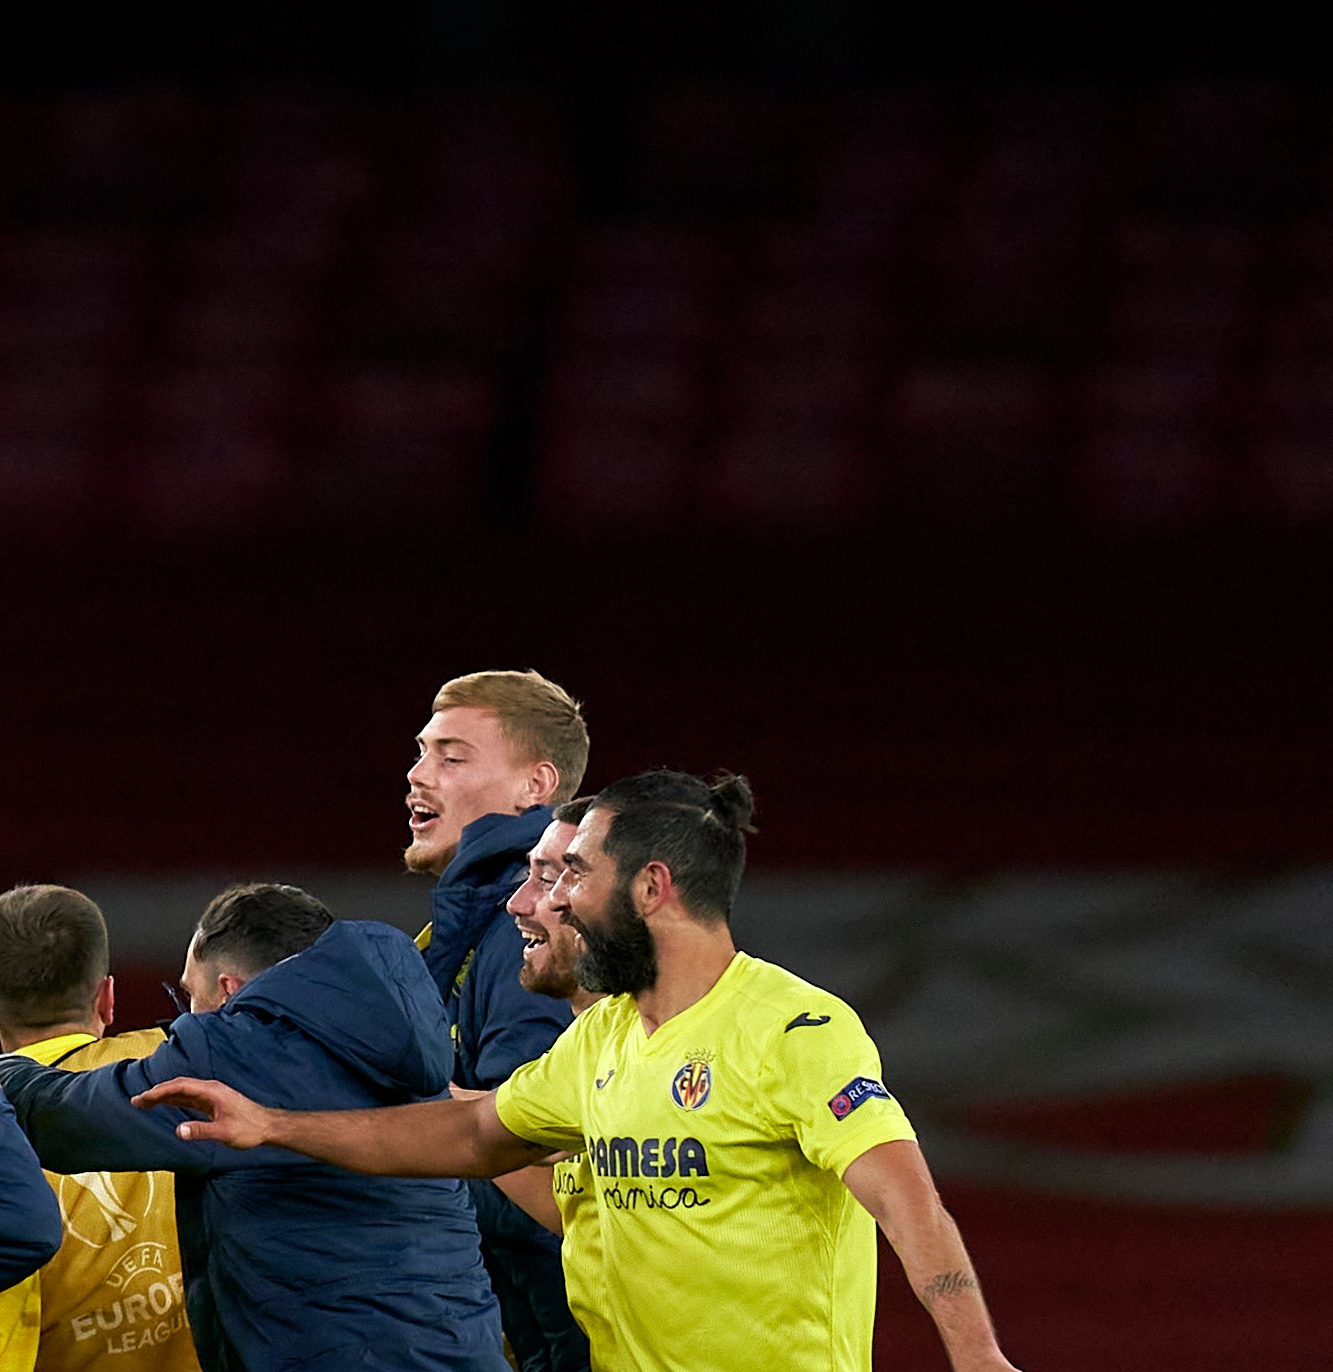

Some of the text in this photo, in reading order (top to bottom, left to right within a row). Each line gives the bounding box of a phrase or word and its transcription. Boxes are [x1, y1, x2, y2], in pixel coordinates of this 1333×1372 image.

[106, 1248, 163, 1288] UEFA
[72, 1272, 184, 1342] EUROP
[108, 1311, 188, 1354] LEAGU
